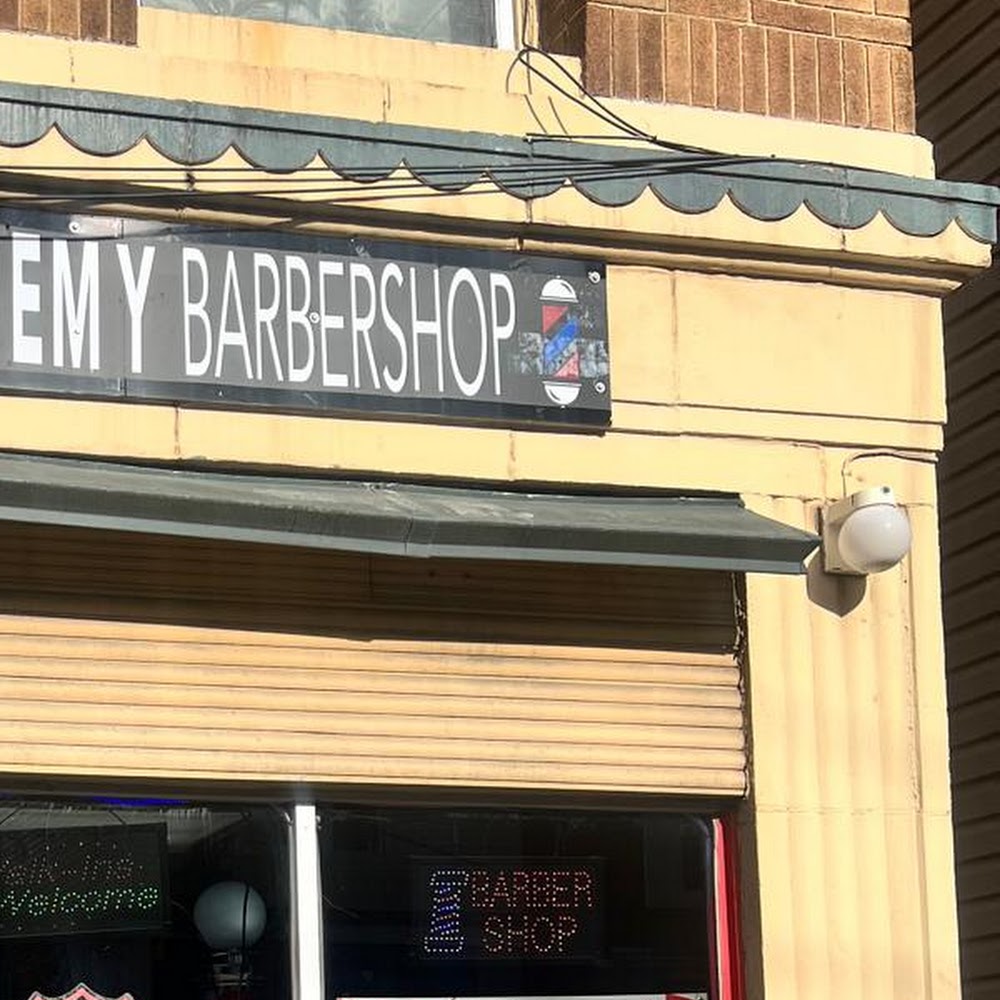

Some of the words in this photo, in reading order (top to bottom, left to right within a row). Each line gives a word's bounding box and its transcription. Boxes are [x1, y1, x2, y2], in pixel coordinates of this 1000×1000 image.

[181, 246, 517, 398] BARBERSHOP
[470, 870, 593, 908] BARBER
[483, 915, 578, 953] SHOP
